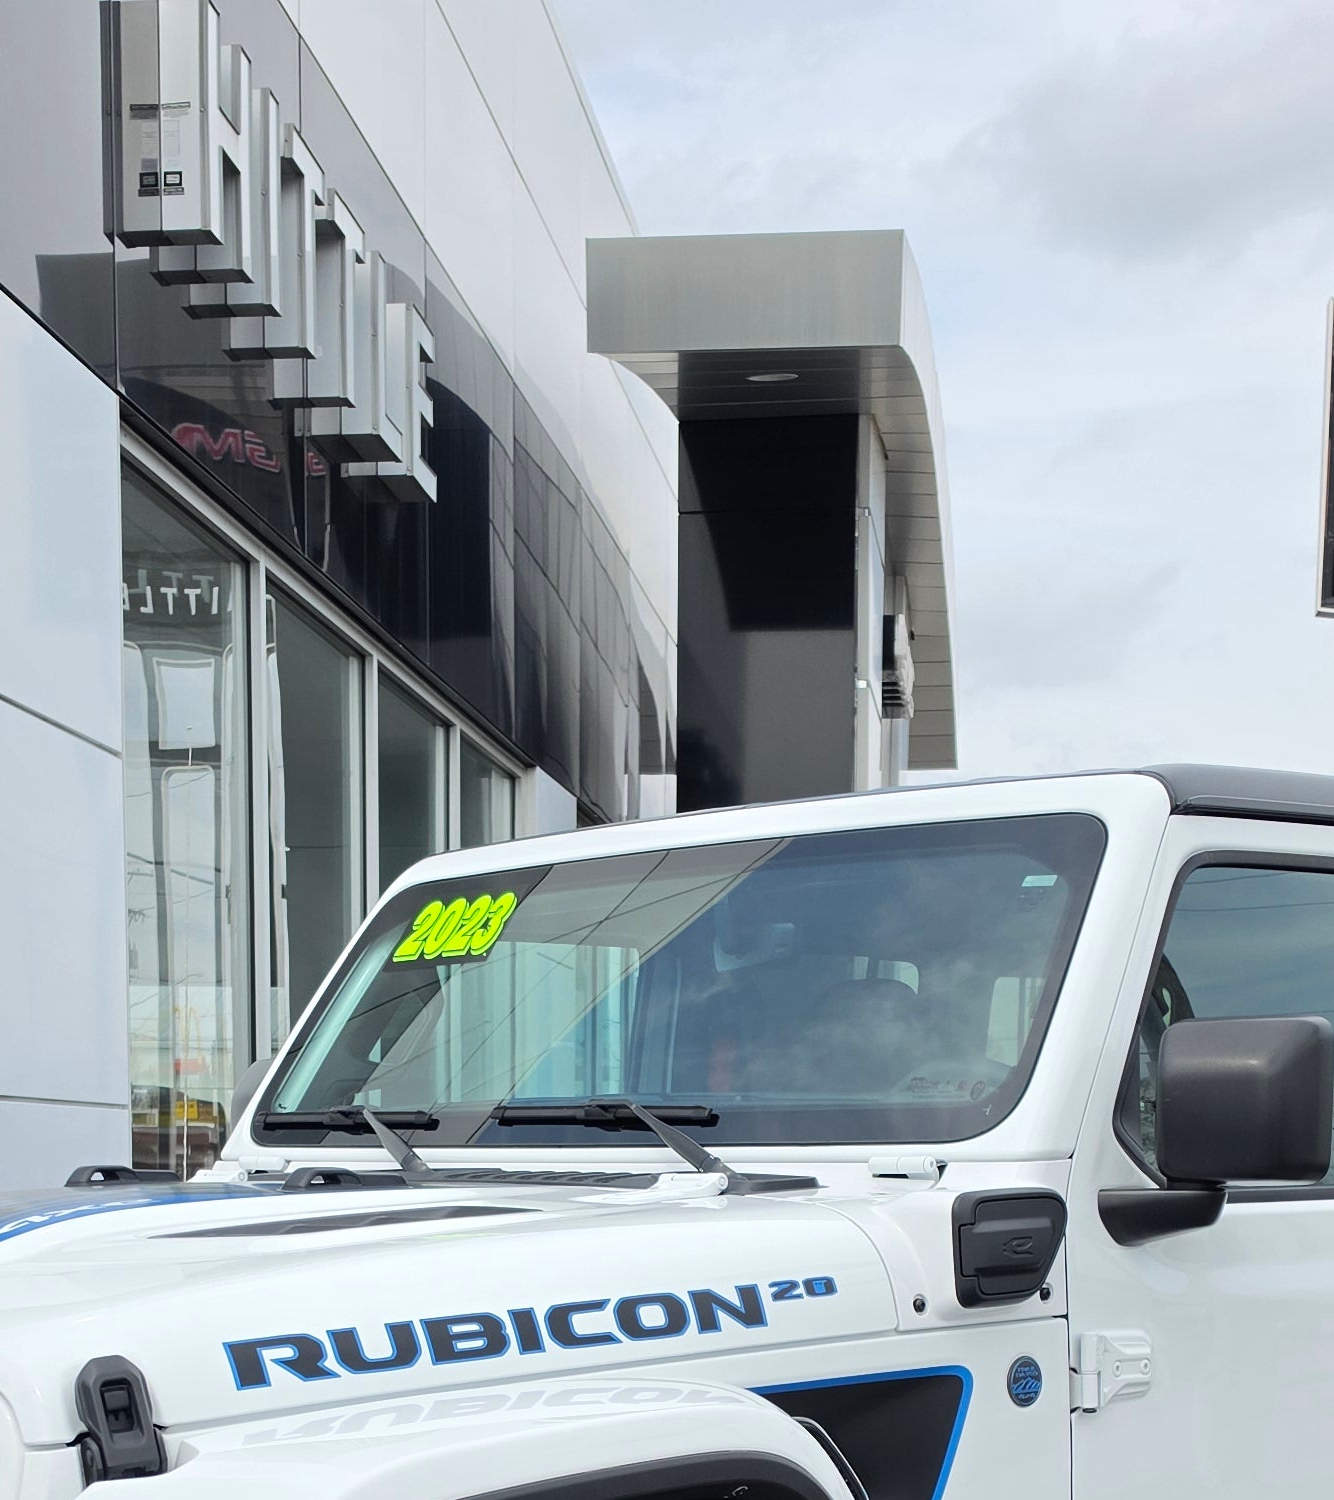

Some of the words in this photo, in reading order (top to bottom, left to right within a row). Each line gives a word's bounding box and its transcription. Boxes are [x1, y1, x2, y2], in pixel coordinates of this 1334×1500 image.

[392, 891, 518, 963] 2023
[222, 1283, 769, 1391] RUBICON
[768, 1276, 838, 1302] 20
